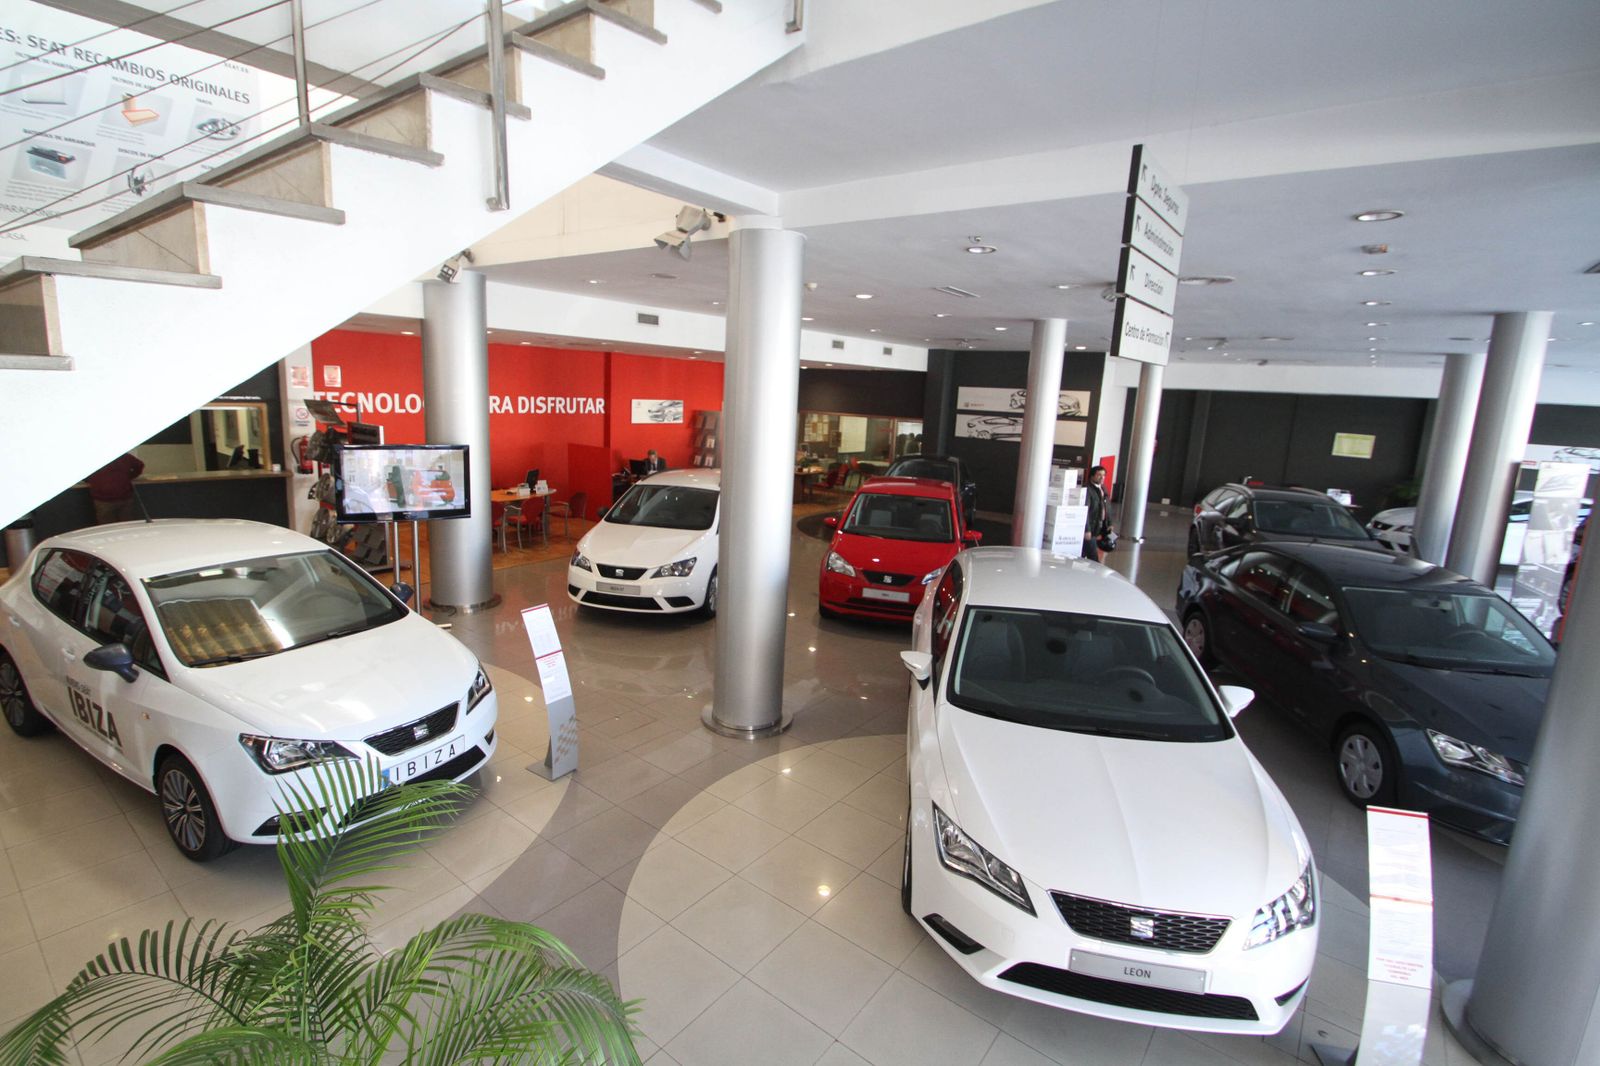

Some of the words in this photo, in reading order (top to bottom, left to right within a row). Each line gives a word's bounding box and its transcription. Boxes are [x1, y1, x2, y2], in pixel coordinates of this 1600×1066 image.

[26, 34, 67, 56] SEAT
[73, 47, 165, 82] RECAMBIOS
[169, 73, 251, 105] ORIGINALES
[1125, 321, 1140, 339] Centro
[1139, 327, 1146, 341] de
[518, 396, 605, 414] DISFRUTAR
[67, 686, 122, 747] IBIZA
[1124, 967, 1151, 978] LEON
